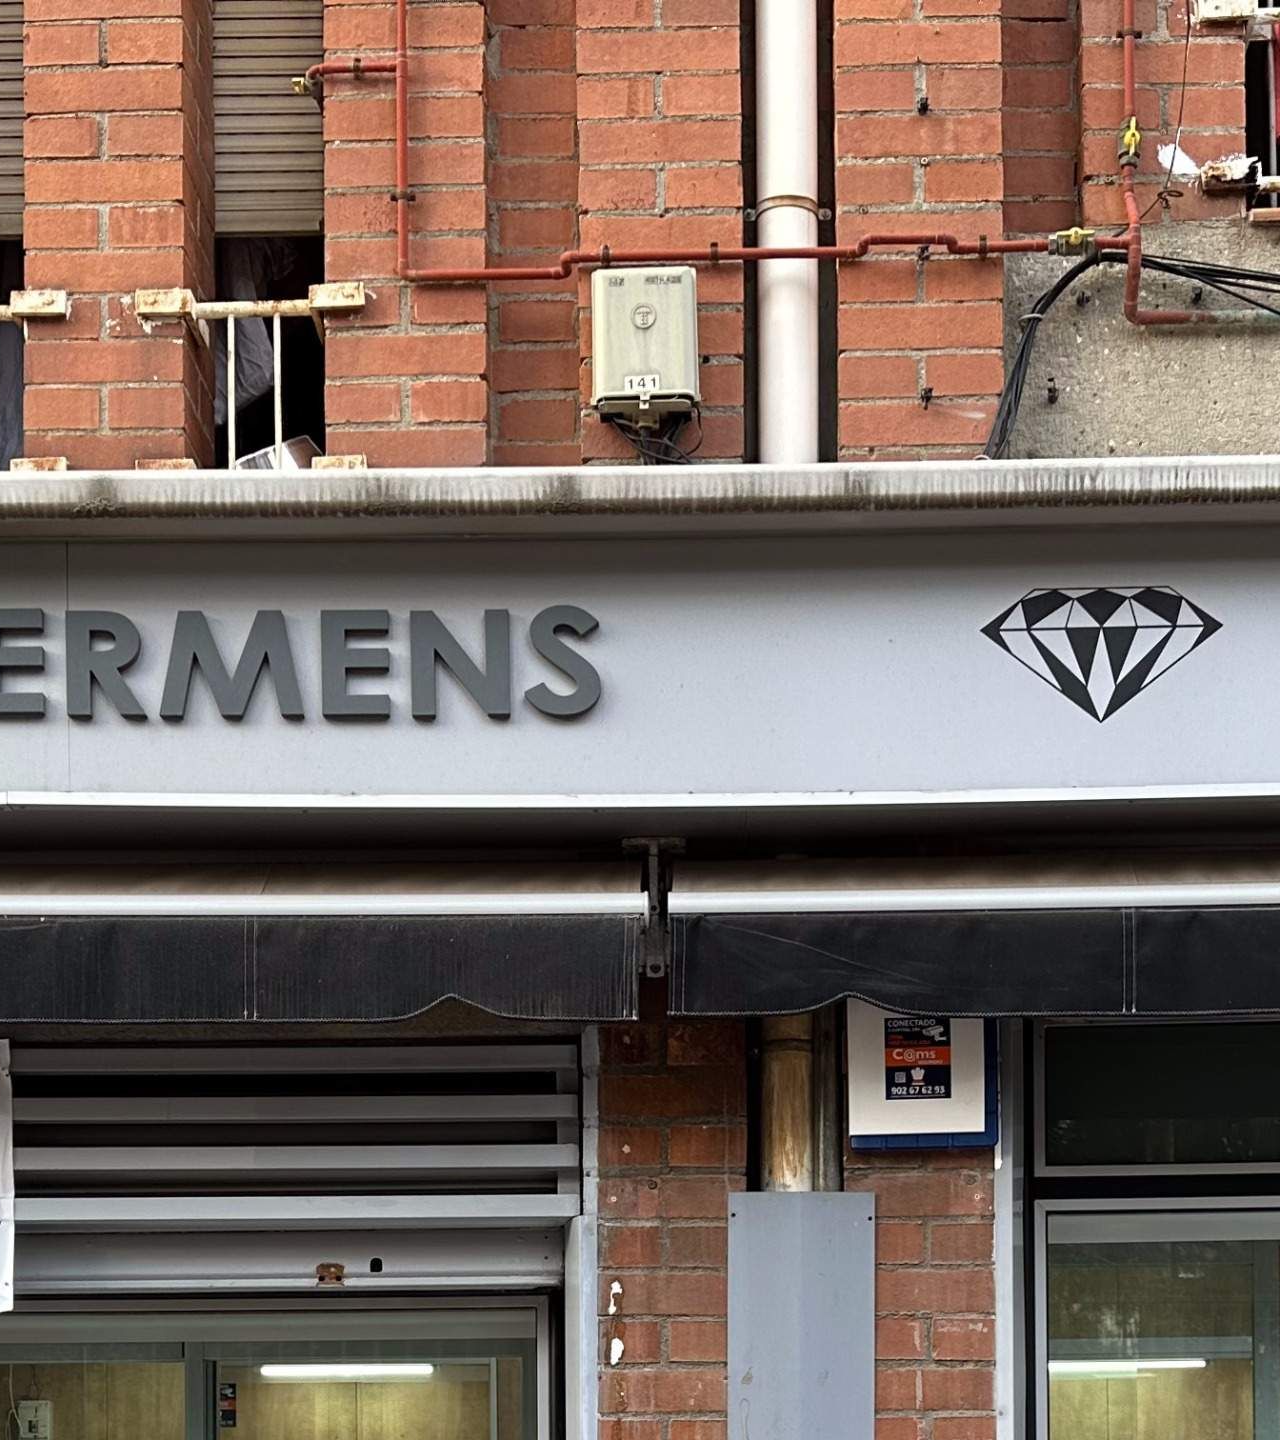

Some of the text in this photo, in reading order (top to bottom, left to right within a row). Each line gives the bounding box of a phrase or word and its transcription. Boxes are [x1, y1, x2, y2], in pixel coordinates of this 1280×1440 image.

[887, 1018, 936, 1028] CONECTADO
[892, 1048, 936, 1063] C@ms
[891, 1085, 945, 1096] 902 67 62 93
